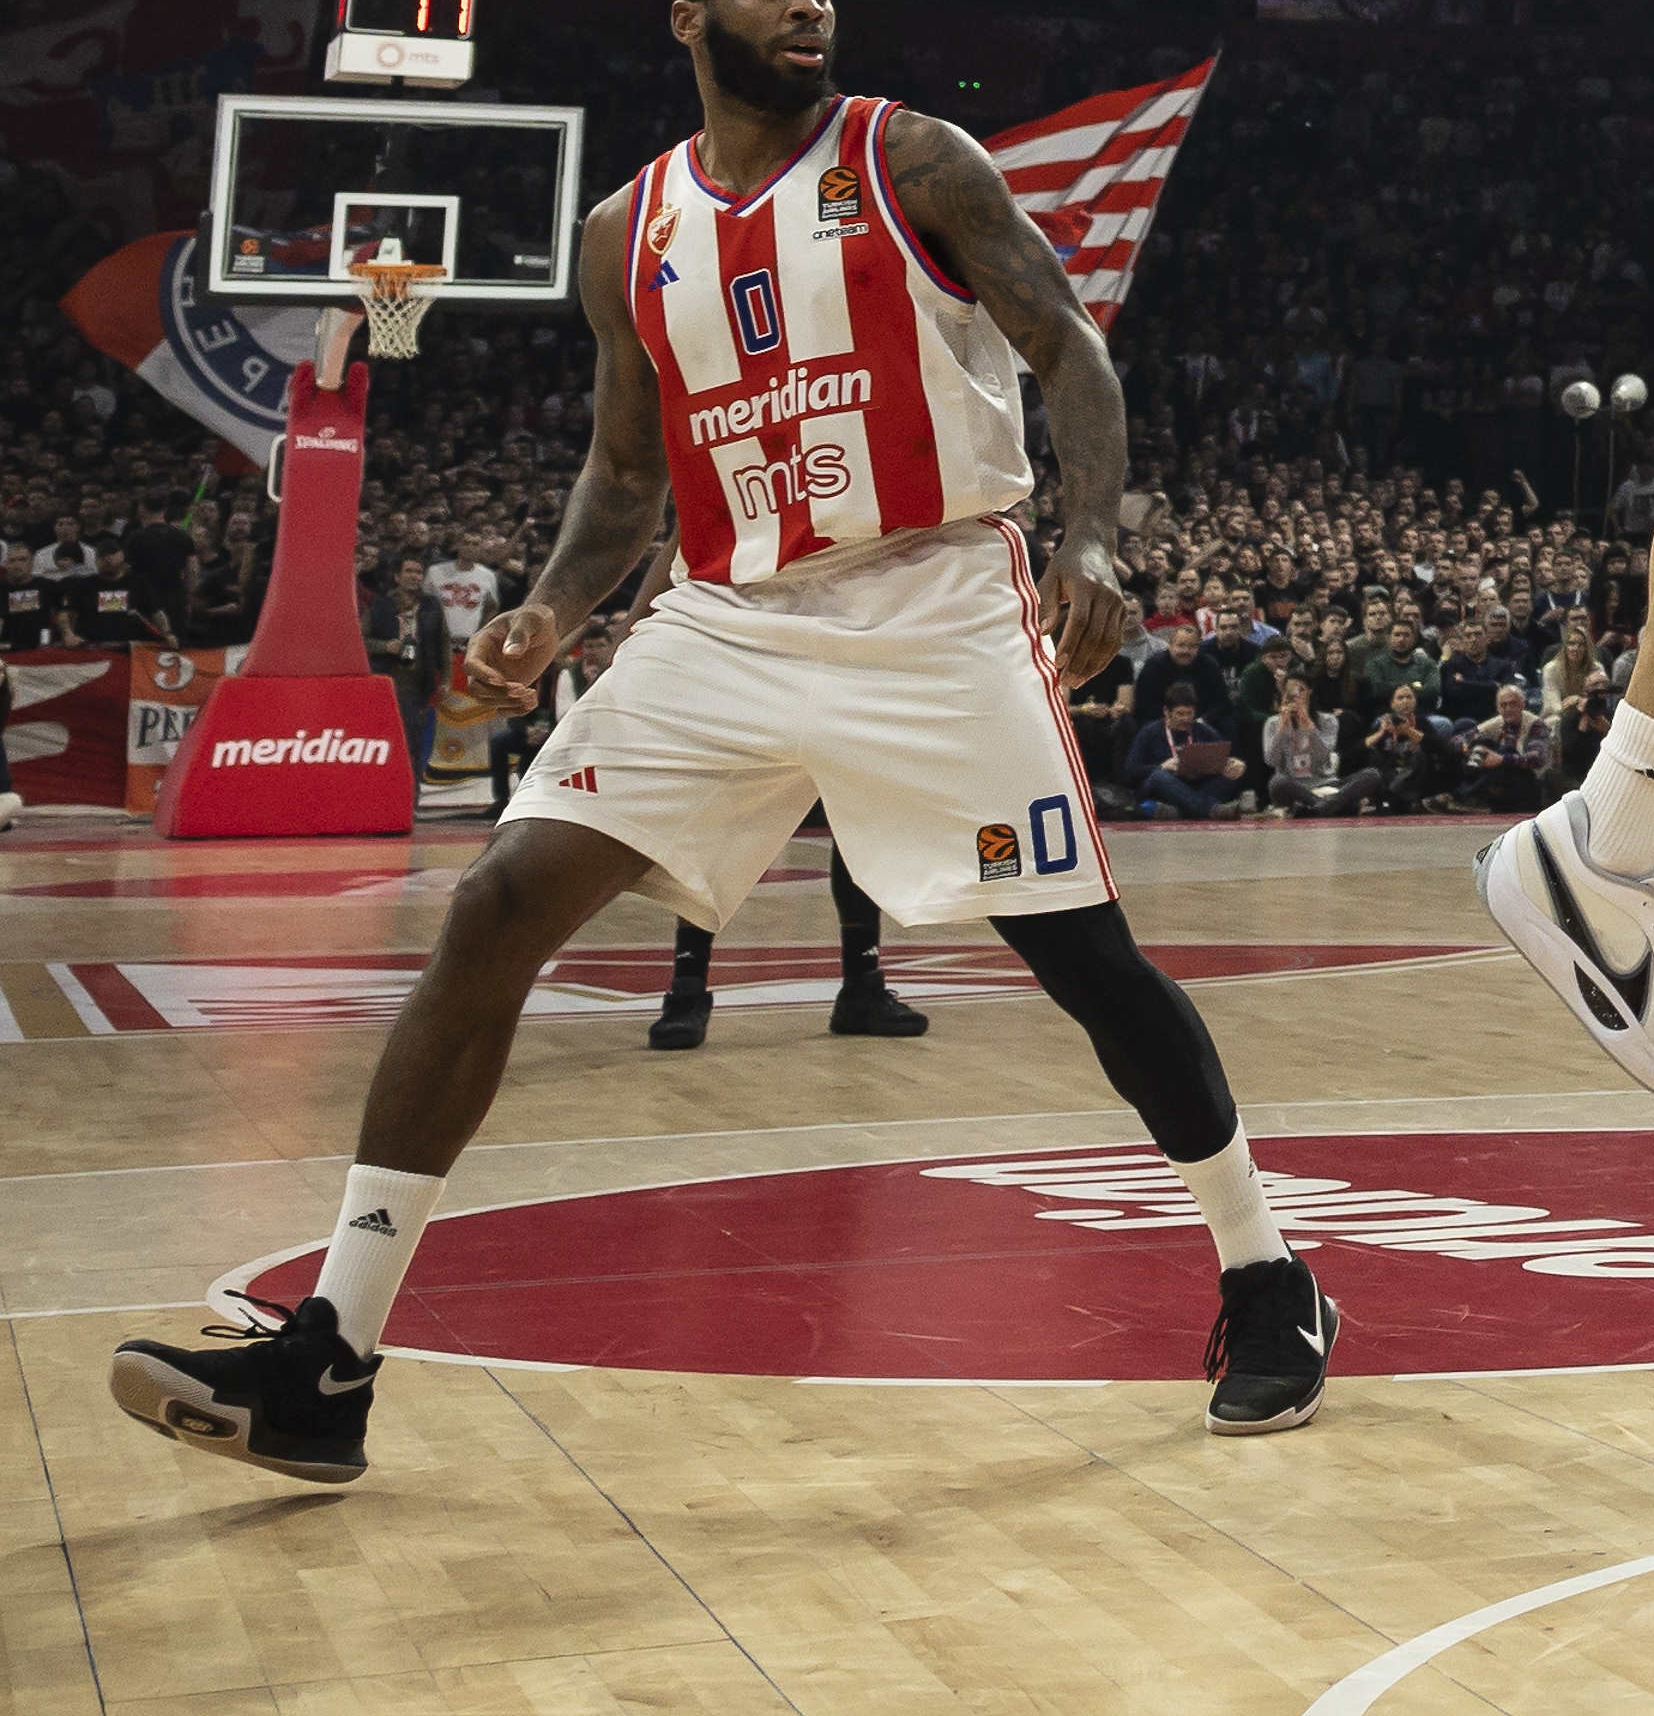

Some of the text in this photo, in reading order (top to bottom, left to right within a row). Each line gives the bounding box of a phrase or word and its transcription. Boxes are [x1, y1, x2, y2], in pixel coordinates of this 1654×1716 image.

[730, 268, 782, 355] 0
[688, 366, 873, 446] meridian
[732, 442, 852, 520] mts
[211, 728, 391, 770] meridian
[1028, 794, 1080, 876] 0
